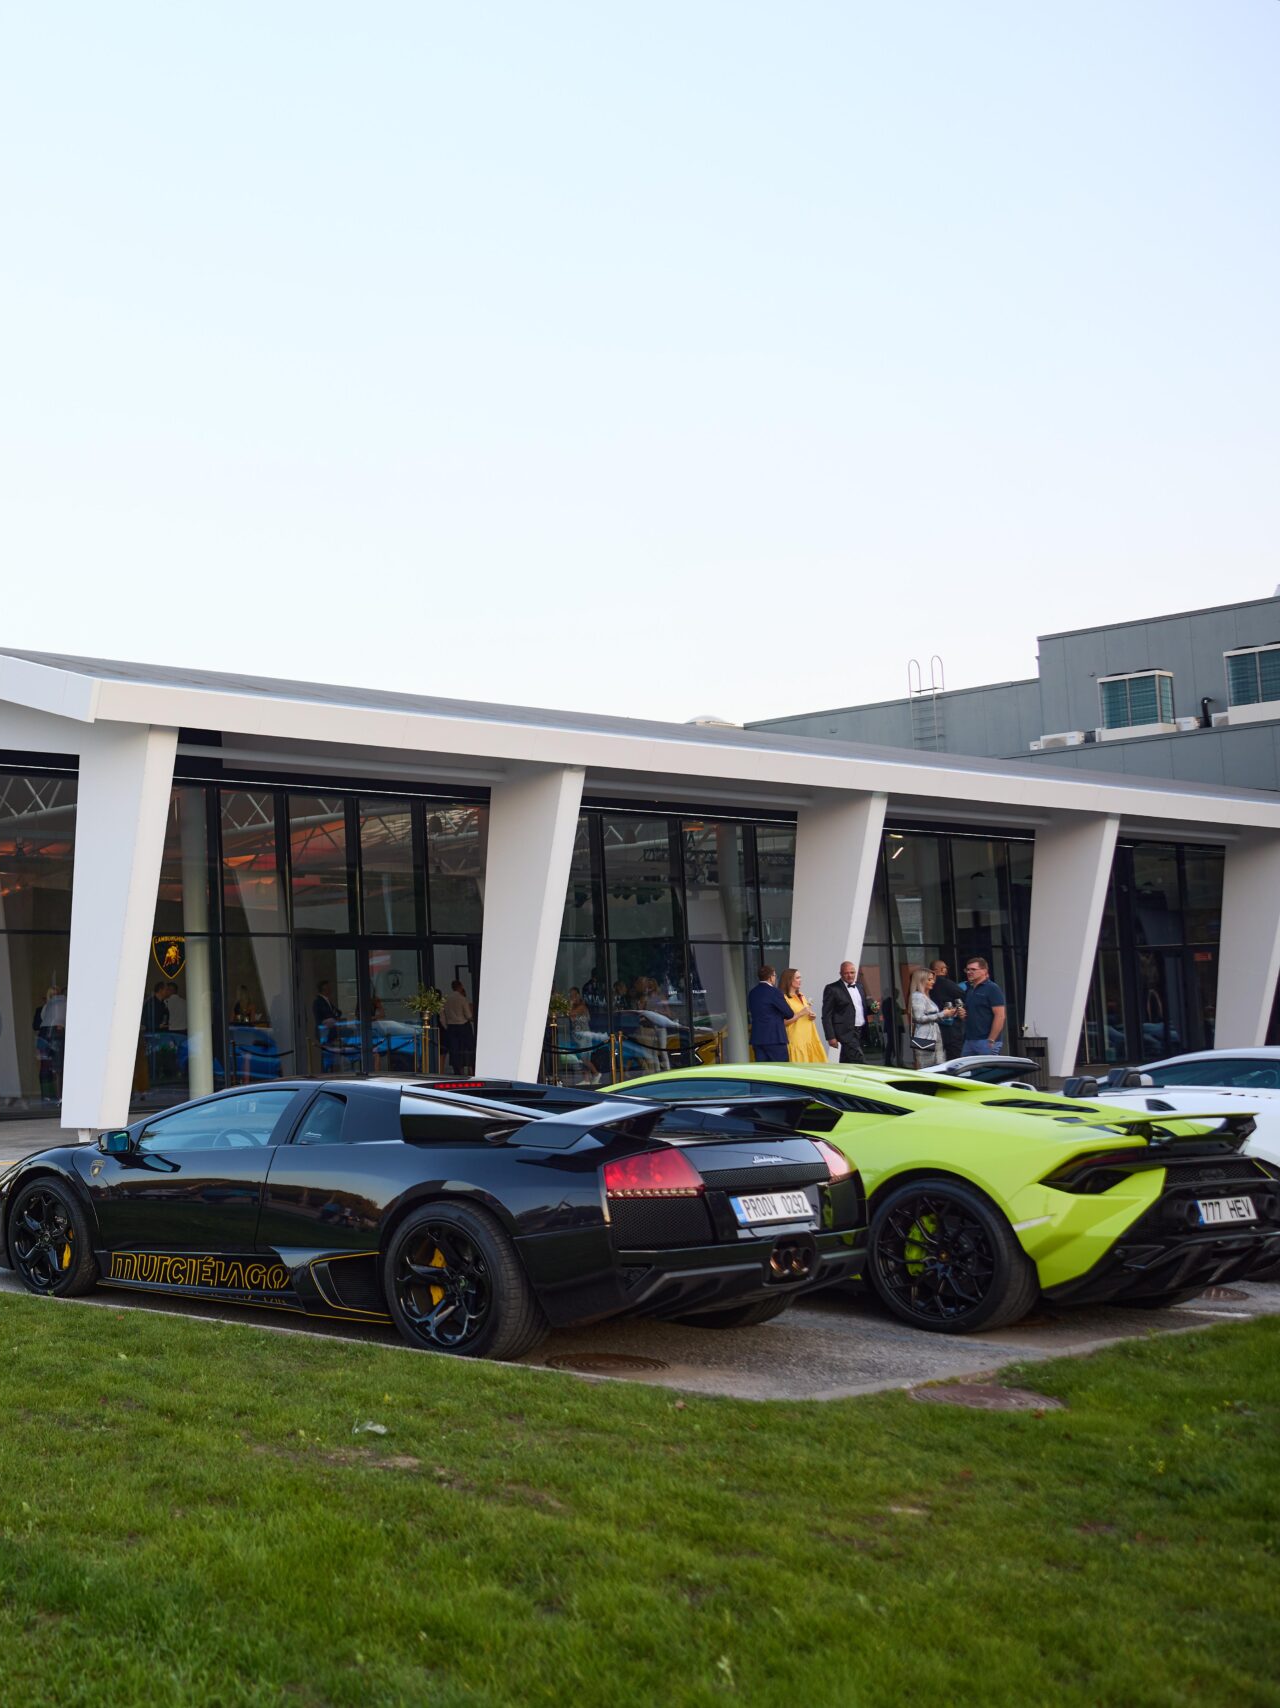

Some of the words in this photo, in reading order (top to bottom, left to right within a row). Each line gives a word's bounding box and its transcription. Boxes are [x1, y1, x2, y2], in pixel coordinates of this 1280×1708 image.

[780, 1194, 809, 1215] 0292
[1201, 1202, 1221, 1220] 777
[1226, 1198, 1251, 1218] HEV
